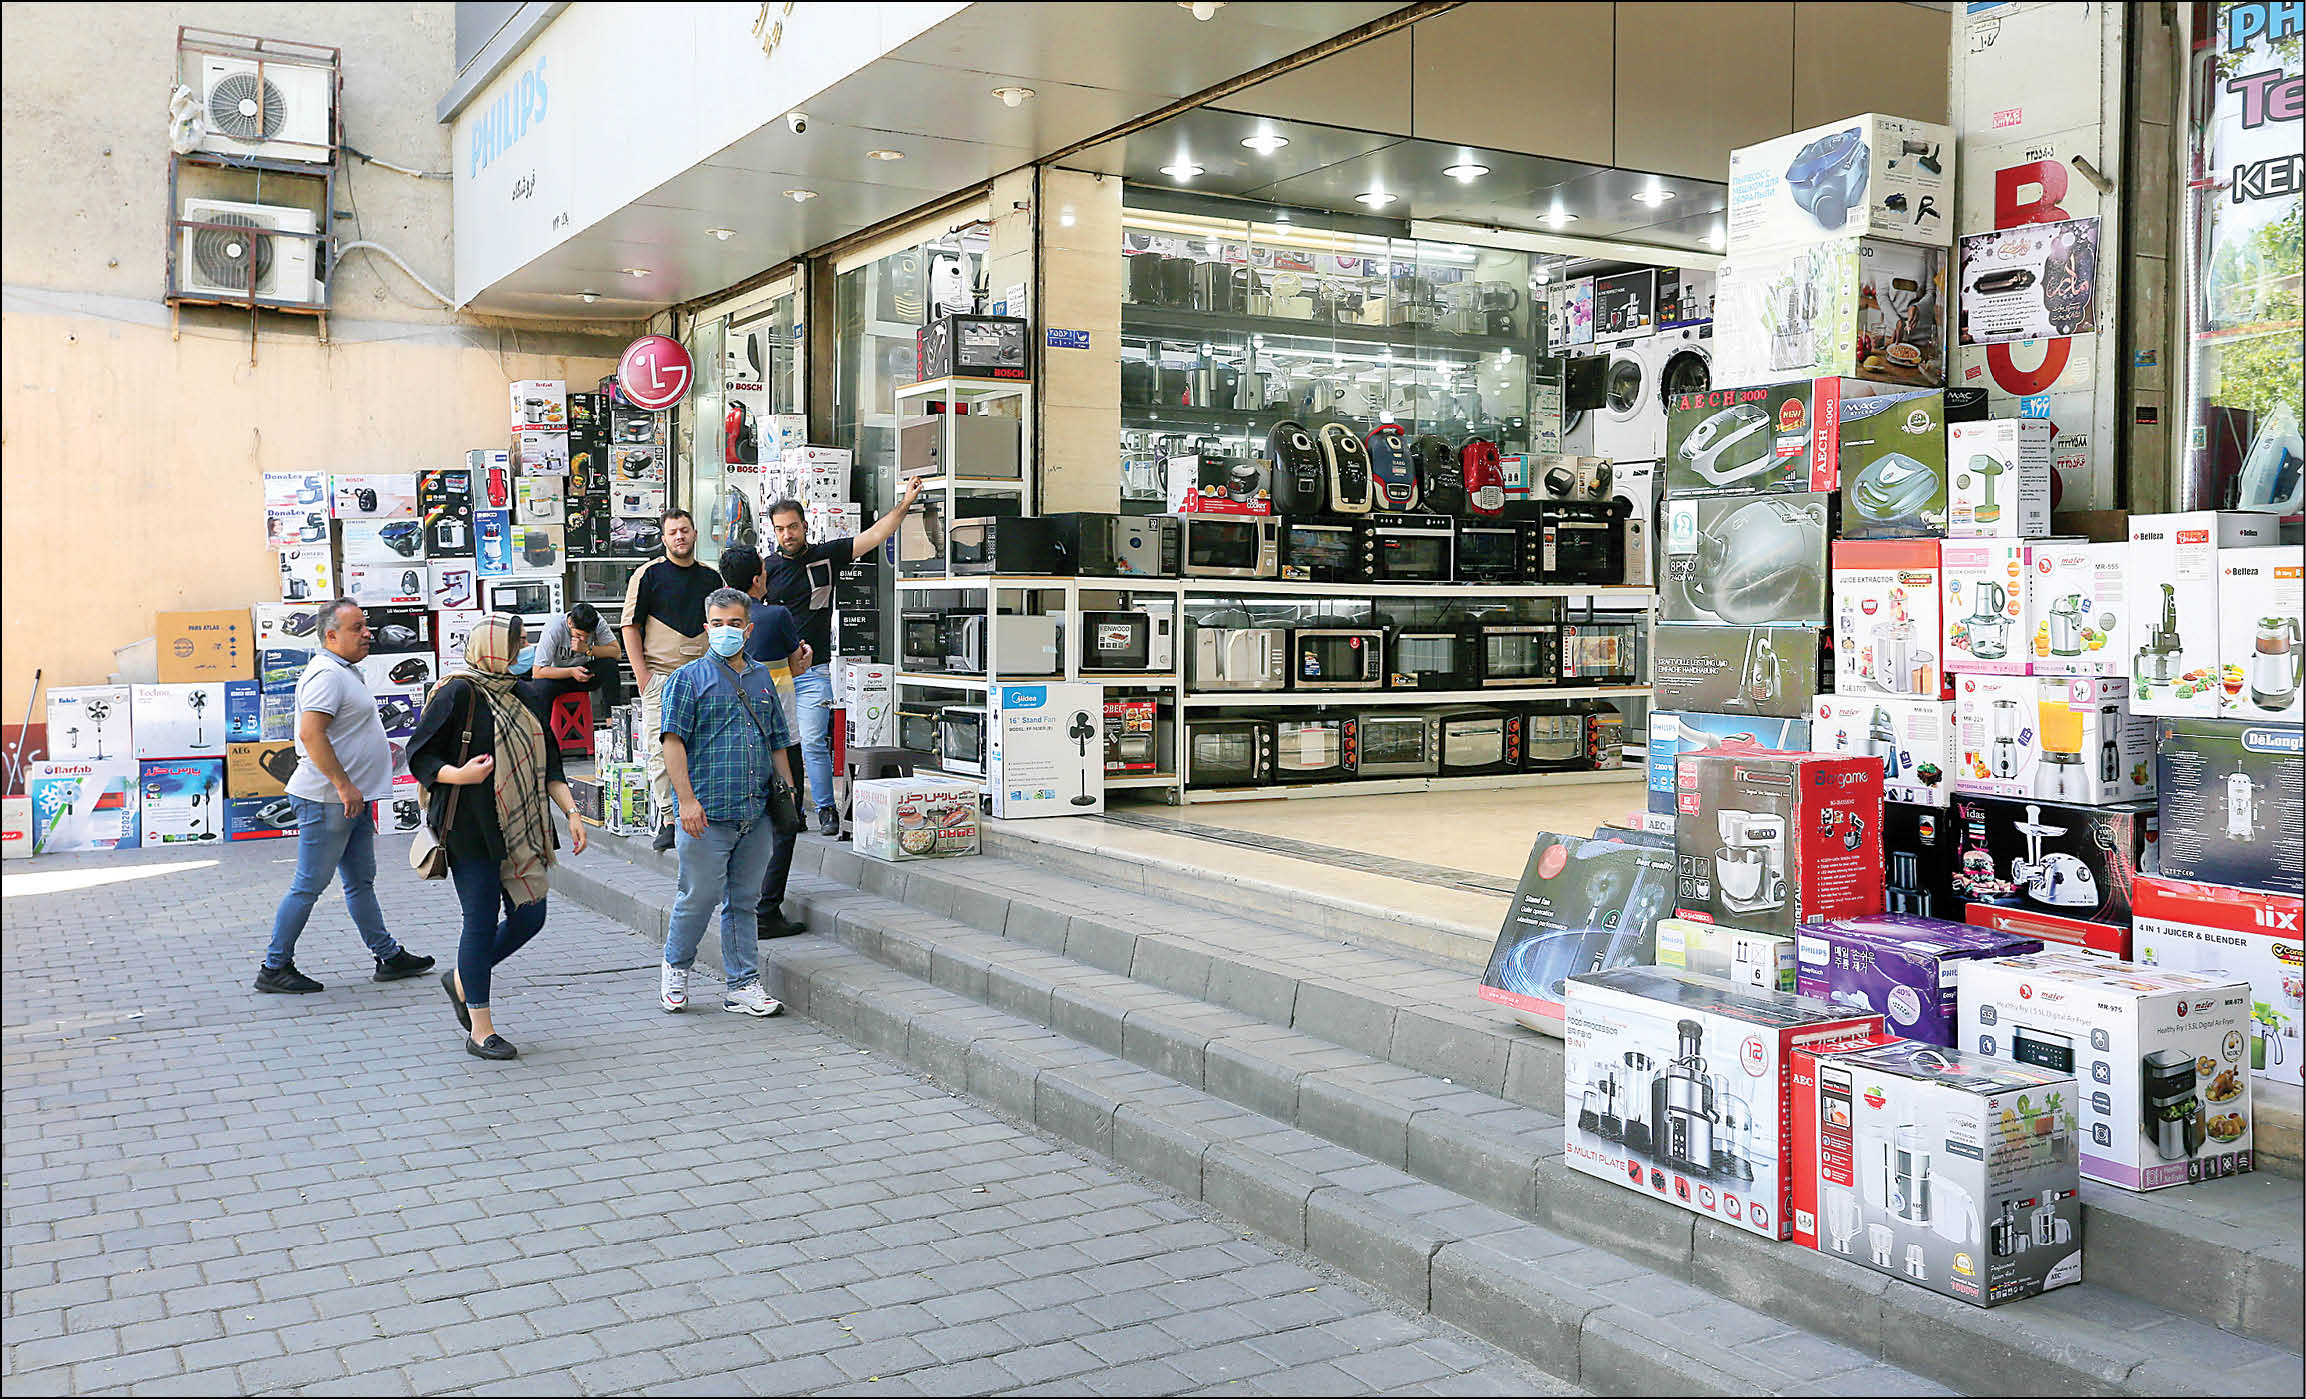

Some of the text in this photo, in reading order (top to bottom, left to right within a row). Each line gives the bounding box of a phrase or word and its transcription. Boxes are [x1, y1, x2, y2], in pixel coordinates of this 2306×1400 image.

[471, 55, 549, 180] PHILIPS
[994, 368, 1025, 378] BOSCH
[735, 382, 763, 392] BOSCH
[1739, 389, 1769, 402] 3000
[1817, 399, 1835, 474] AECH 3000
[267, 509, 306, 517] DonaLex
[2140, 531, 2164, 541] Belleza
[1670, 560, 1696, 572] 8PRO
[2232, 567, 2259, 576] Belleza
[1839, 576, 1857, 584] JUICE
[1857, 575, 1894, 583] EXTRACTOR
[1652, 722, 1677, 732] PHILIPS
[232, 747, 250, 755] AEG
[54, 765, 92, 774] Barfab
[169, 767, 201, 777] پارس
[898, 791, 924, 804] خزر
[924, 792, 959, 804] پارس
[2146, 925, 2154, 933] IN
[2163, 927, 2194, 939] JUICER
[2196, 931, 2202, 939] &
[2204, 933, 2247, 947] BLENDER
[1800, 944, 1827, 958] PHILIPS
[1755, 969, 1761, 980] 6
[1896, 988, 1911, 997] 40%
[1582, 1020, 1618, 1036] PROCESSOR
[2198, 1020, 2215, 1029] Digital
[1747, 1041, 1763, 1062] 12
[1793, 1073, 1814, 1087] AEC
[1574, 1146, 1598, 1161] MULTI
[1599, 1153, 1626, 1171] PLATE
